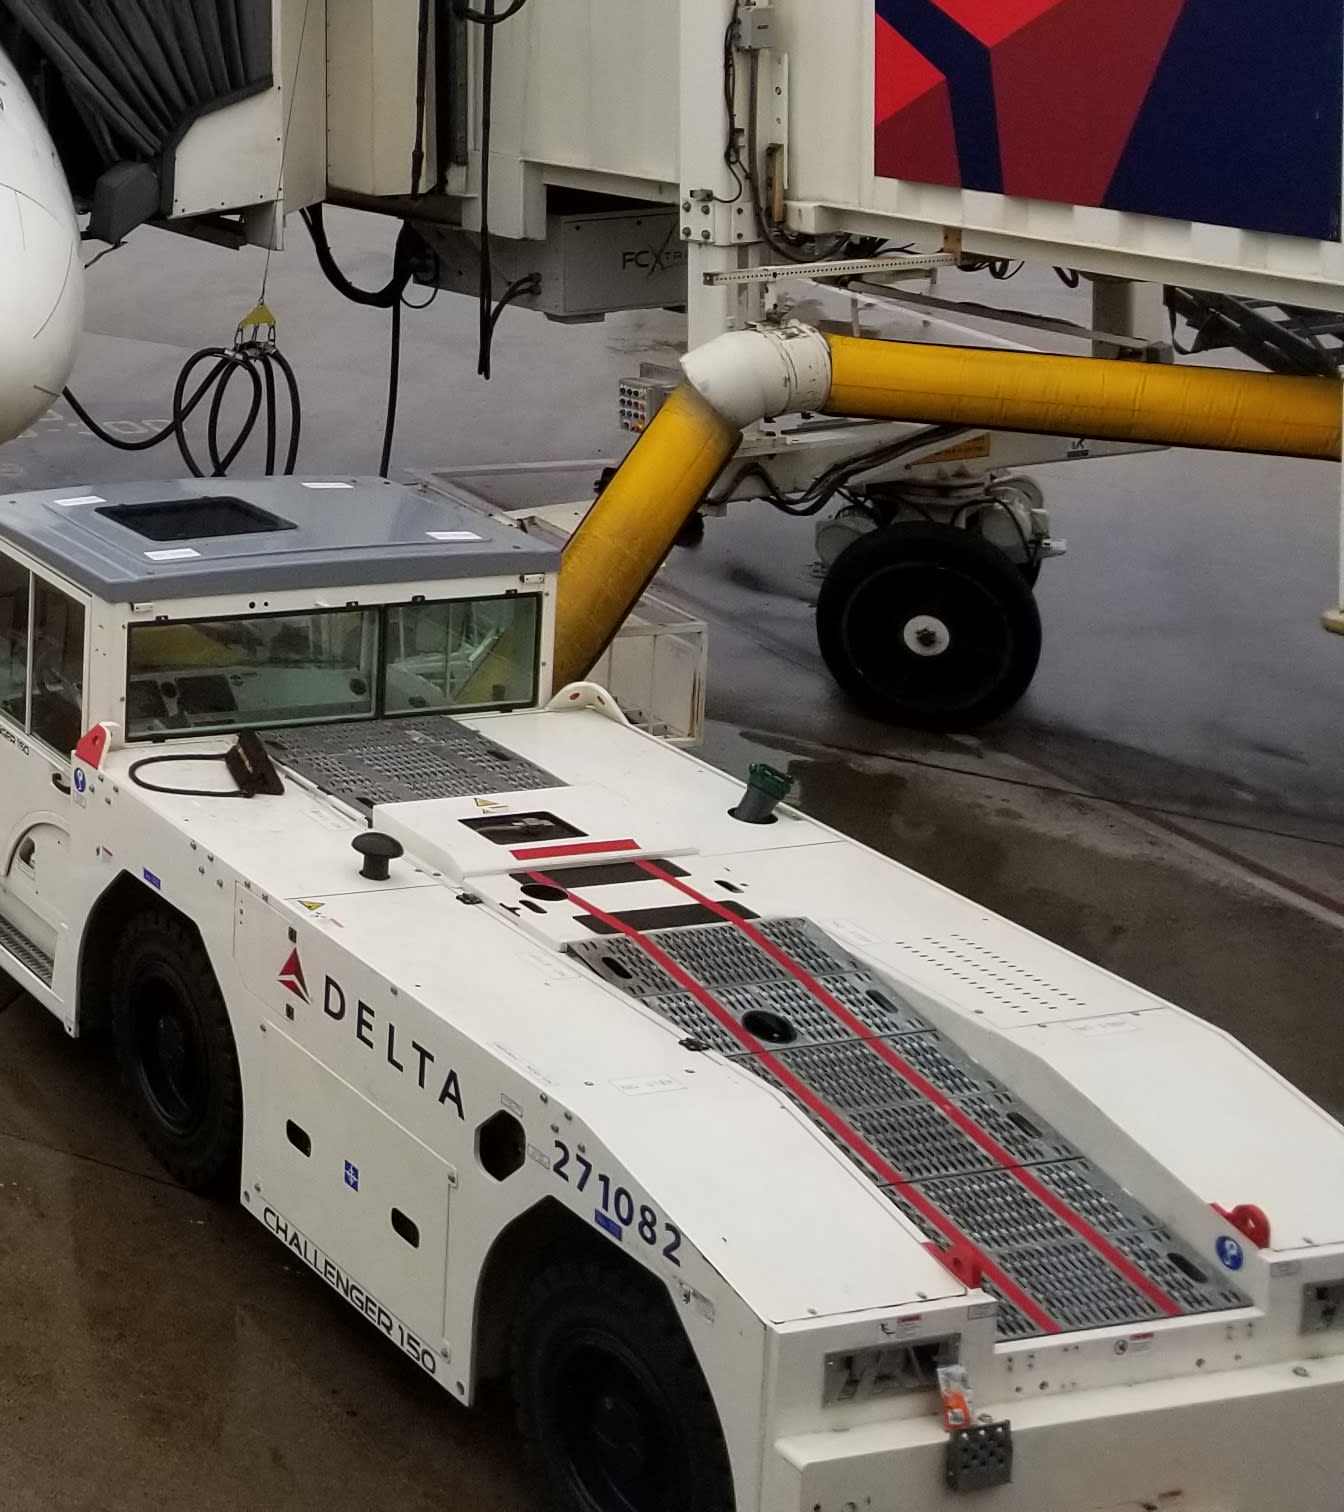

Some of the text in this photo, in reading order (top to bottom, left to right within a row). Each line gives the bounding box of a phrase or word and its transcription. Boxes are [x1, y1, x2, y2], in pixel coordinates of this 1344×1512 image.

[16, 739, 30, 756] 150
[323, 974, 465, 1121] DELTA
[552, 1140, 682, 1267] 271082
[263, 1206, 437, 1375] CHALLENGER 150
